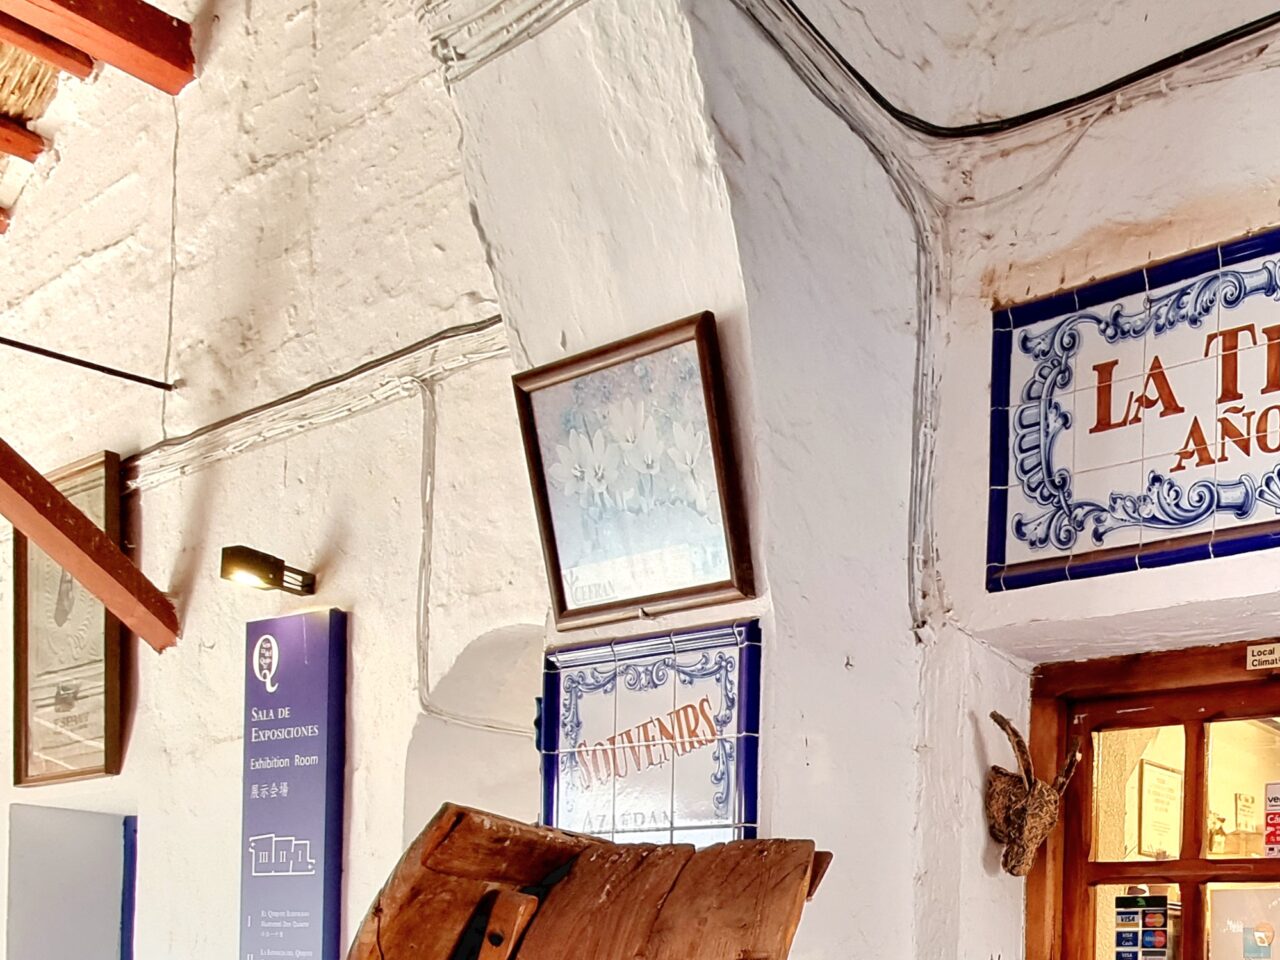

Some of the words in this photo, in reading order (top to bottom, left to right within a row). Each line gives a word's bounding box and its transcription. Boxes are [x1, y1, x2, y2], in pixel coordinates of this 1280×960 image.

[1090, 354, 1185, 434] LA
[1252, 647, 1276, 658] Local
[252, 707, 275, 721] SALA
[278, 707, 292, 719] DE
[251, 724, 319, 742] EXPOSICIONES
[576, 693, 718, 790] SOUVENIRS
[250, 755, 290, 770] Exhibition
[294, 754, 319, 767] Room
[1120, 915, 1136, 923] VISA
